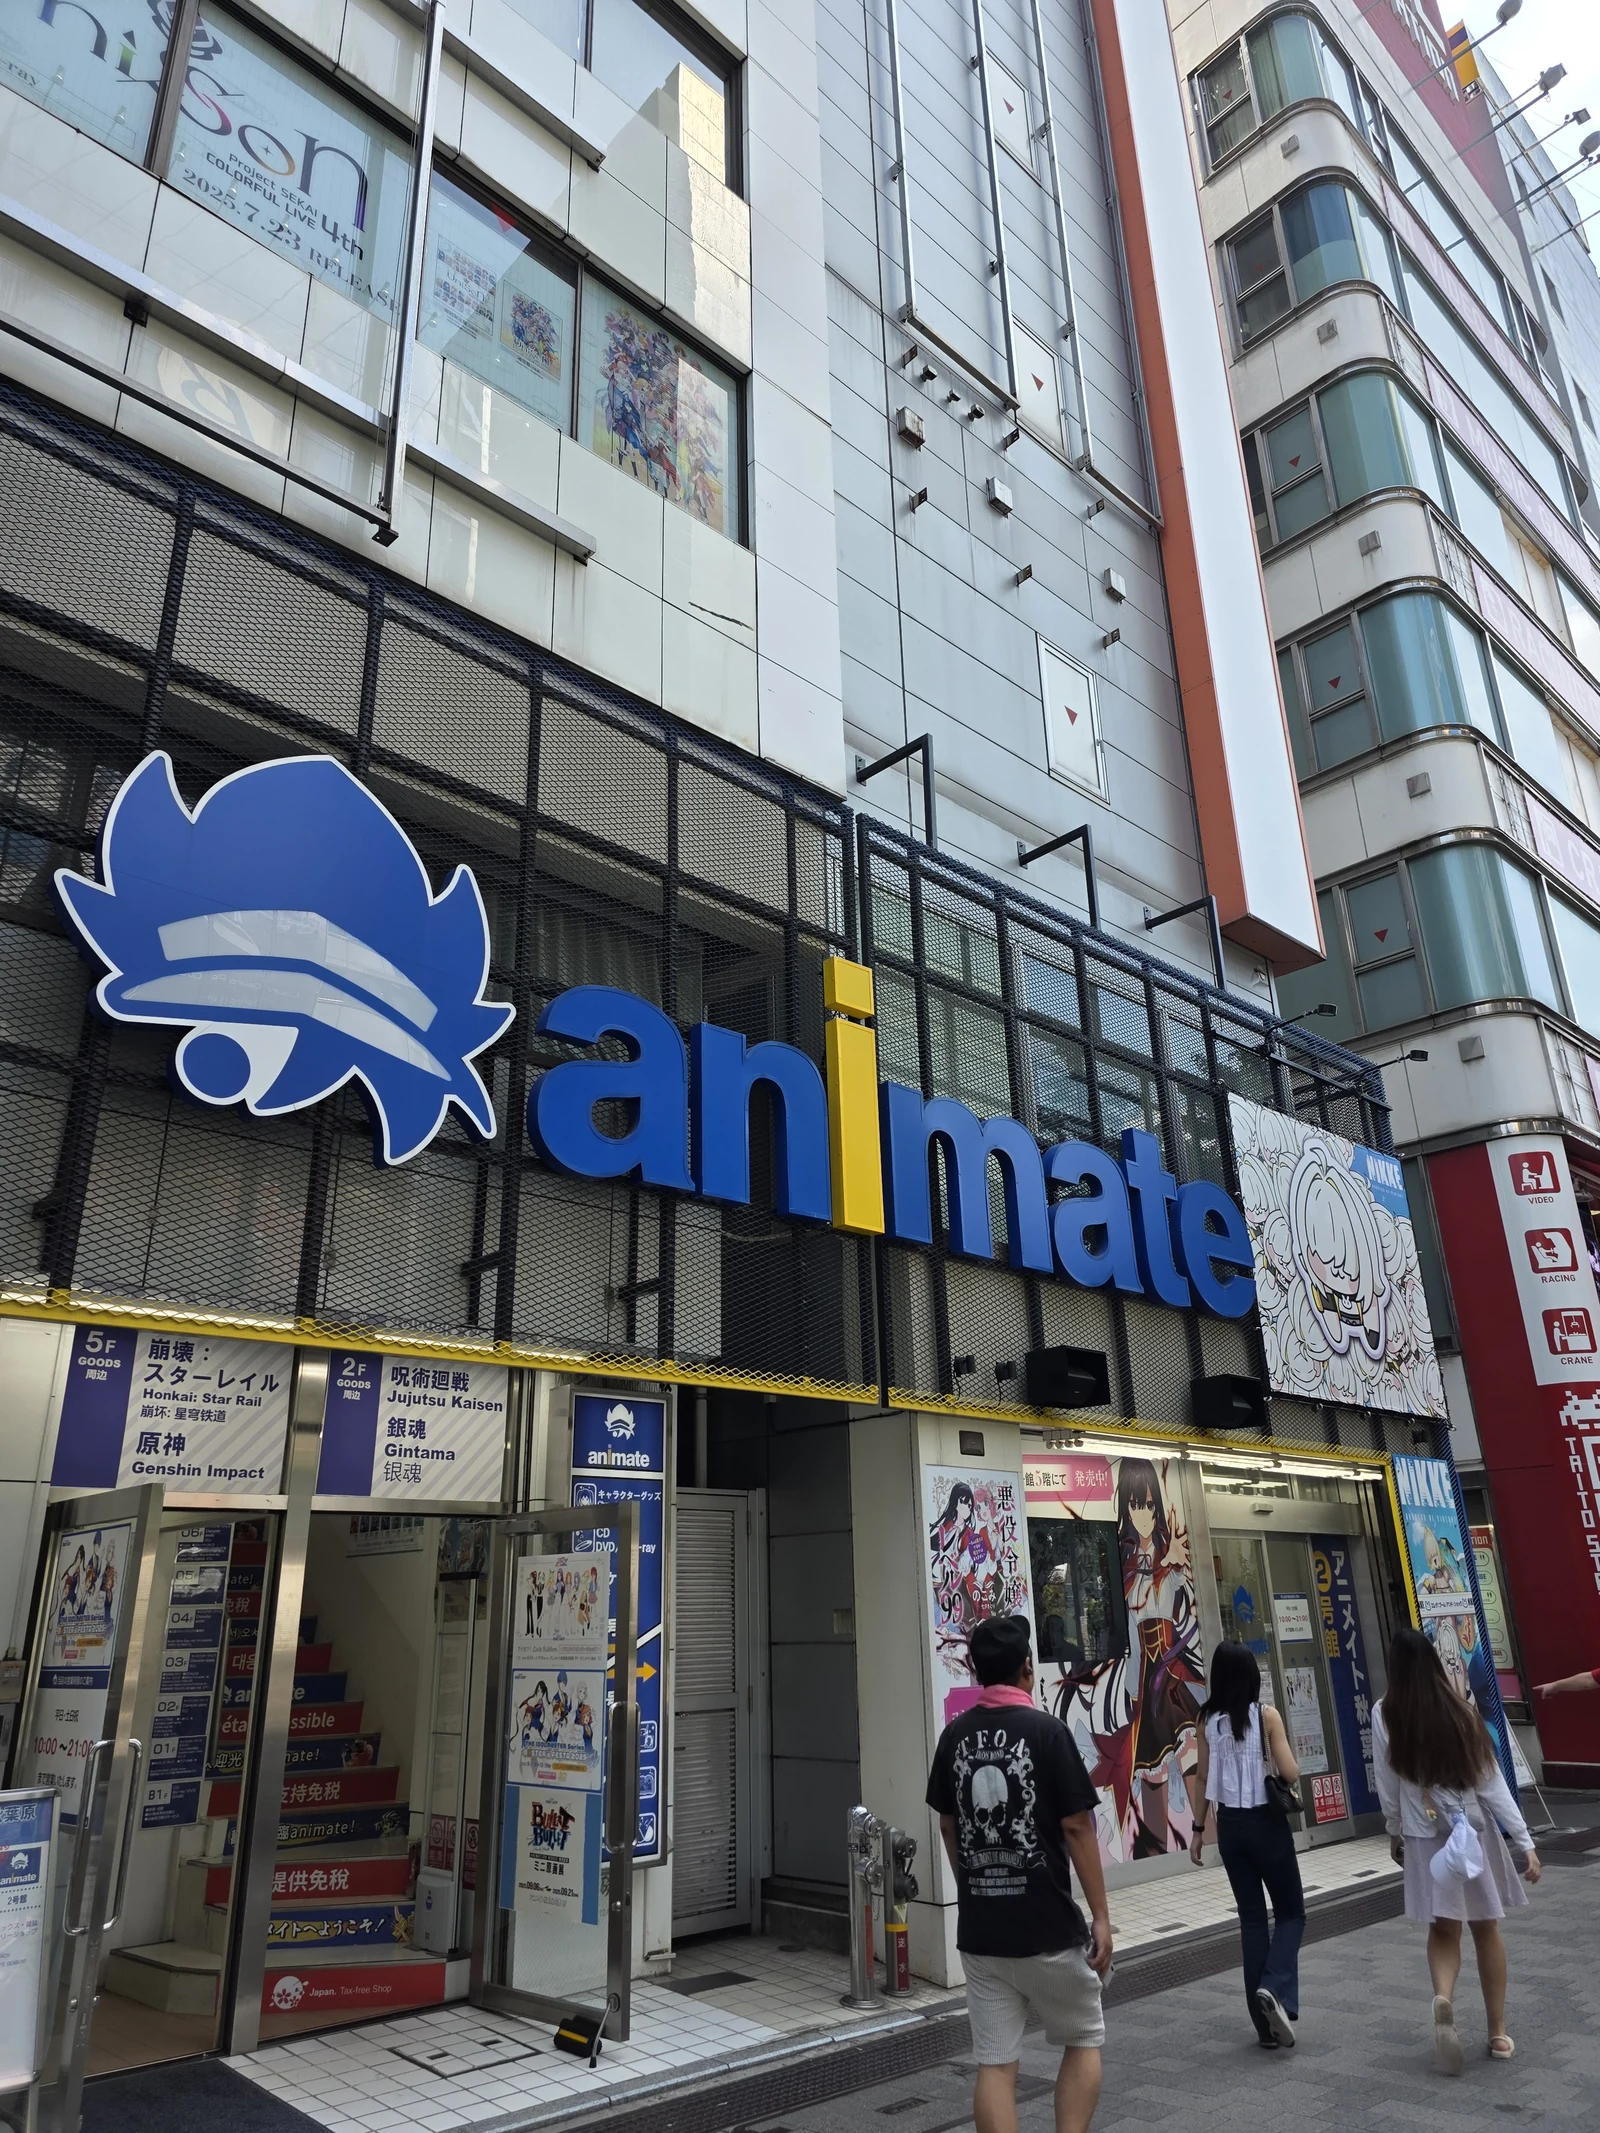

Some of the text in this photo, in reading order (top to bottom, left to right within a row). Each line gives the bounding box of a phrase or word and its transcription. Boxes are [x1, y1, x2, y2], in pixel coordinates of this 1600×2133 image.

[228, 153, 319, 218] Project SEKAI
[205, 152, 364, 261] COLORFUL LIVE 4th
[1465, 414, 1533, 513] MUSIC
[527, 956, 1256, 1320] animate
[1366, 1155, 1404, 1191] NIKKE
[1527, 1195, 1555, 1206] VIDEO
[1541, 1274, 1577, 1284] RACING
[85, 1330, 116, 1354] 5F
[77, 1356, 122, 1368] GOODS
[341, 1357, 367, 1376] 2F
[1560, 1355, 1594, 1366] CRANE
[143, 1363, 280, 1393] スターレイル
[336, 1378, 371, 1389] GOODS
[391, 1366, 470, 1393] 呪術廻戦
[142, 1388, 262, 1407] Honkai: Star Rail
[387, 1390, 503, 1412] Jujutsu Kaisen
[387, 1416, 427, 1440] 銀魂
[135, 1431, 187, 1457] 原神
[384, 1443, 456, 1461] Gintama
[588, 1444, 650, 1468] animate
[131, 1461, 265, 1481] Genshin Impact
[383, 1460, 422, 1484] 银魂
[1396, 1457, 1456, 1509] NIKKE
[597, 1489, 662, 1502] キャラクターグッズ
[596, 1527, 610, 1538] CD
[996, 1485, 1024, 1610] 悪役令嬢
[938, 1525, 964, 1626] レベル99
[0, 1803, 37, 1822] 葉原
[7, 1894, 28, 1906] 2号館
[309, 1984, 392, 1997] Japan. Tax-free Shop
